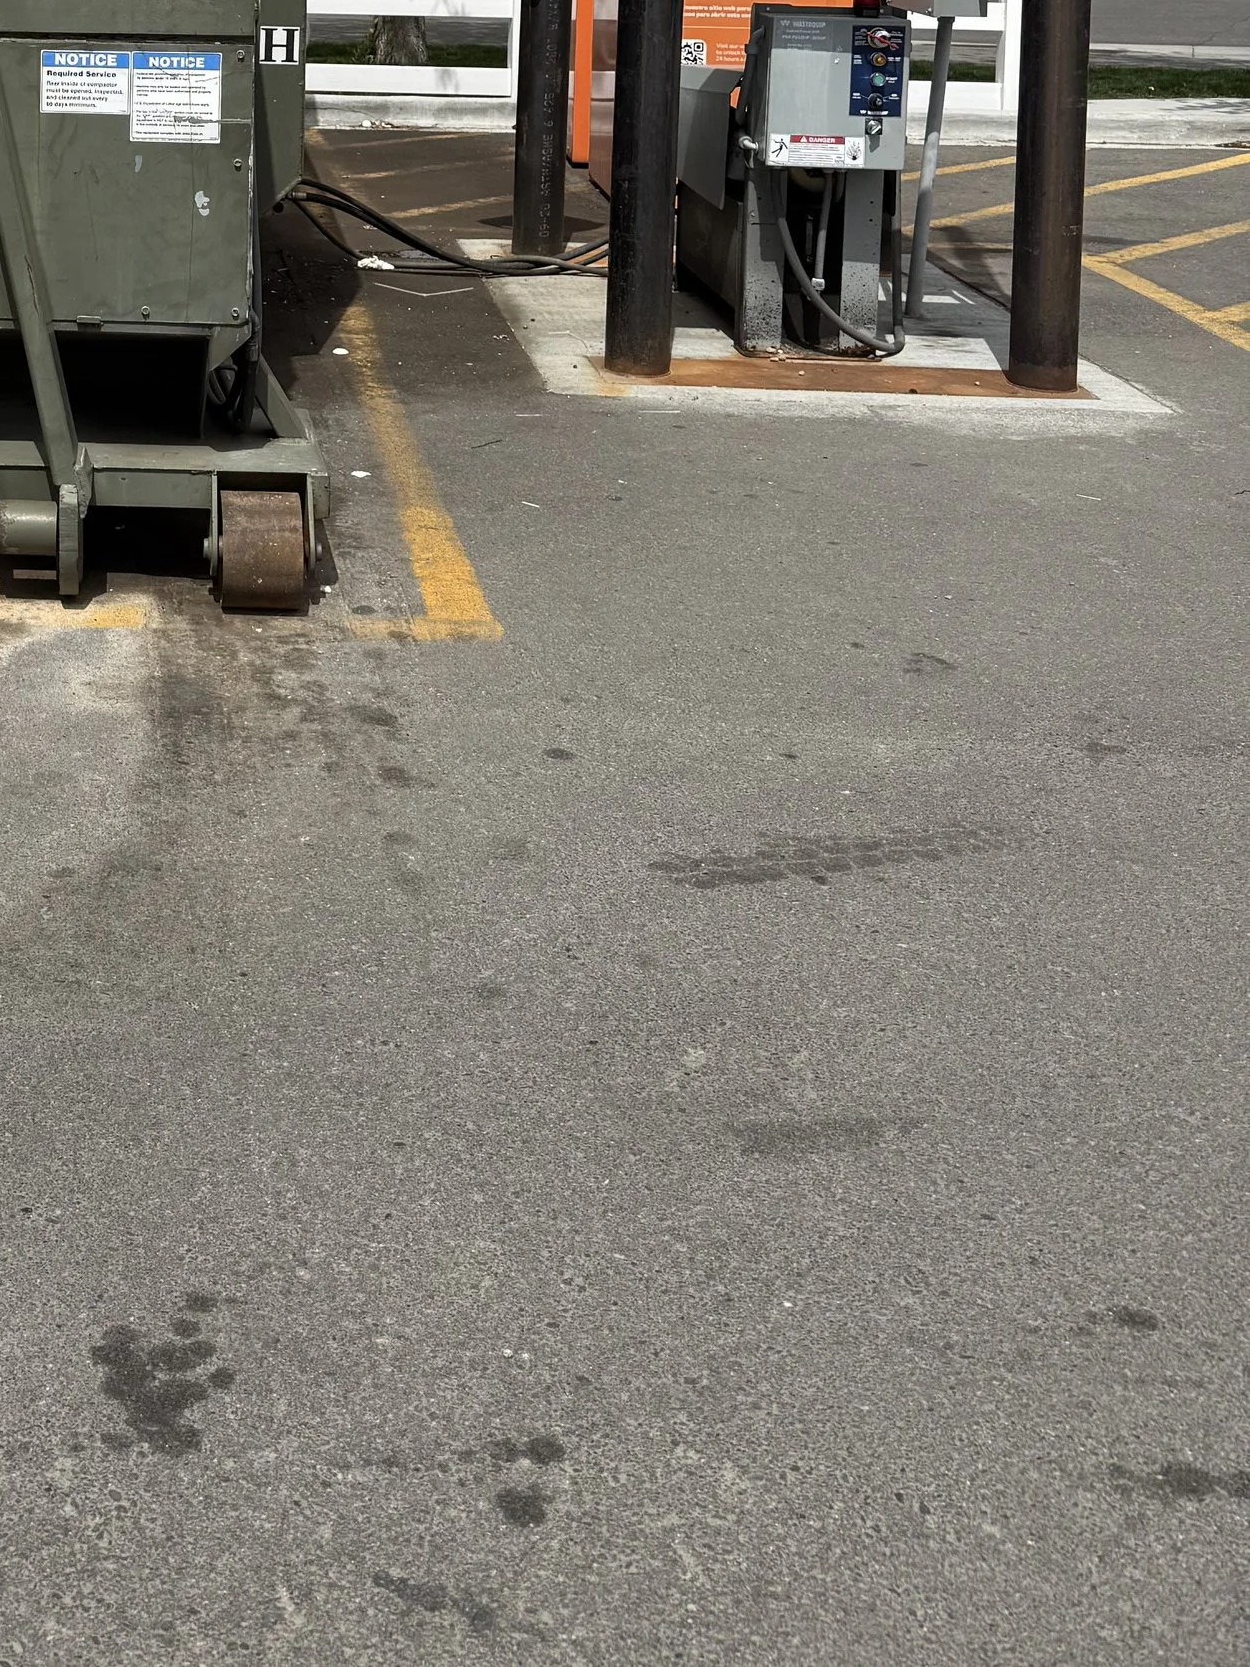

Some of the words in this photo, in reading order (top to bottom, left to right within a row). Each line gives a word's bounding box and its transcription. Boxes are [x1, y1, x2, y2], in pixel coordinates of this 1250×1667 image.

[260, 28, 299, 63] H
[54, 53, 117, 67] NOTICE
[149, 56, 205, 68] NOTICE
[86, 70, 117, 78] Service
